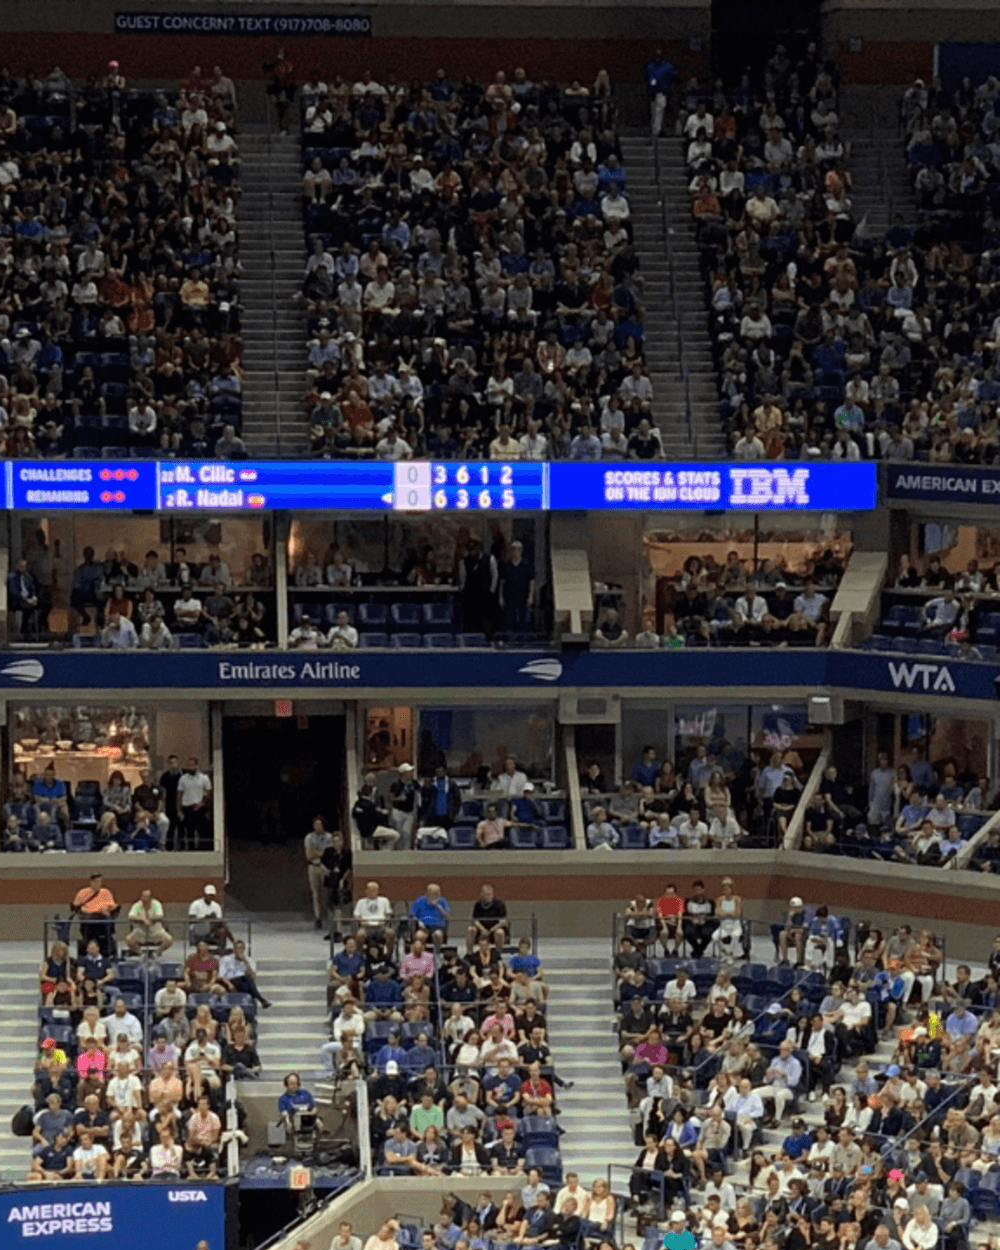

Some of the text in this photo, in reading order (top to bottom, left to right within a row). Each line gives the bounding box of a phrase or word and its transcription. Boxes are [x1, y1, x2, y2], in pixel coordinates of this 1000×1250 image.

[117, 16, 160, 29] GUEST
[163, 17, 235, 30] CONCERN?
[238, 18, 271, 30] TEXT
[20, 468, 93, 482] CHALLENGES
[175, 464, 196, 483] M.
[199, 464, 236, 483] Cilic
[407, 466, 419, 484] 0
[434, 465, 448, 485] 3
[456, 465, 470, 485] 6
[480, 465, 490, 485] 1
[501, 465, 514, 485] 2
[604, 471, 721, 485] SCORES & STATS
[895, 474, 977, 493] AMERICAN
[604, 487, 625, 501] ON
[627, 487, 651, 501] THE
[679, 487, 721, 501] CLOUD
[730, 468, 811, 504] IBM
[176, 488, 194, 507] R.
[197, 488, 244, 508] Nadal
[407, 489, 419, 507] 0
[434, 489, 449, 509] 6
[456, 489, 470, 509] 3
[478, 489, 493, 509] 6
[502, 489, 516, 509] 5
[218, 662, 361, 679] Emirates Airline
[888, 661, 956, 692] WTA
[168, 1190, 208, 1202] USTA
[7, 1201, 111, 1223] AMERICAN
[22, 1217, 113, 1237] EXPRESS
